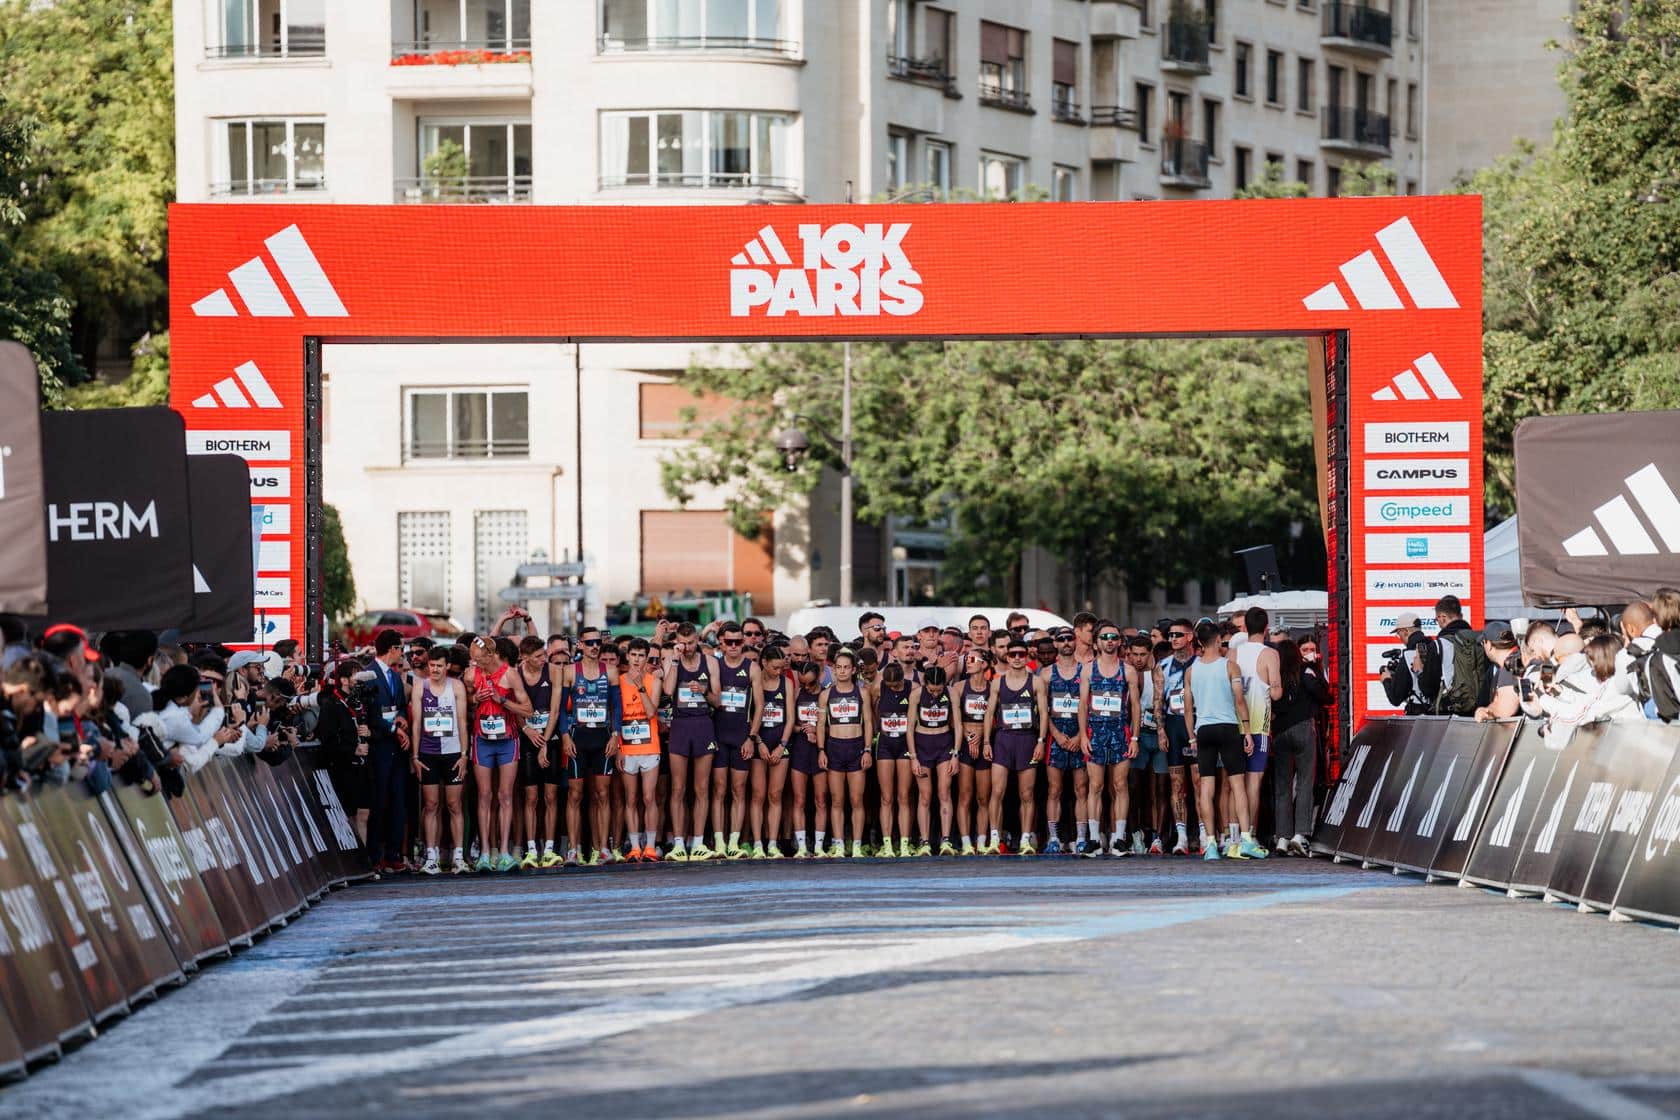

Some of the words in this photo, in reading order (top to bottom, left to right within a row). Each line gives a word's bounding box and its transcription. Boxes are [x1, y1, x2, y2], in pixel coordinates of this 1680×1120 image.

[798, 223, 913, 270] 10K
[730, 267, 924, 317] PARIS
[1384, 431, 1449, 443] BIOTHERM
[205, 439, 271, 451] BIOTHERM
[1376, 469, 1458, 479] CAMPUS
[1380, 502, 1452, 520] Compeed
[1063, 698, 1072, 708] 69
[1103, 697, 1110, 706] 71
[838, 703, 850, 713] 201
[630, 726, 640, 735] 92
